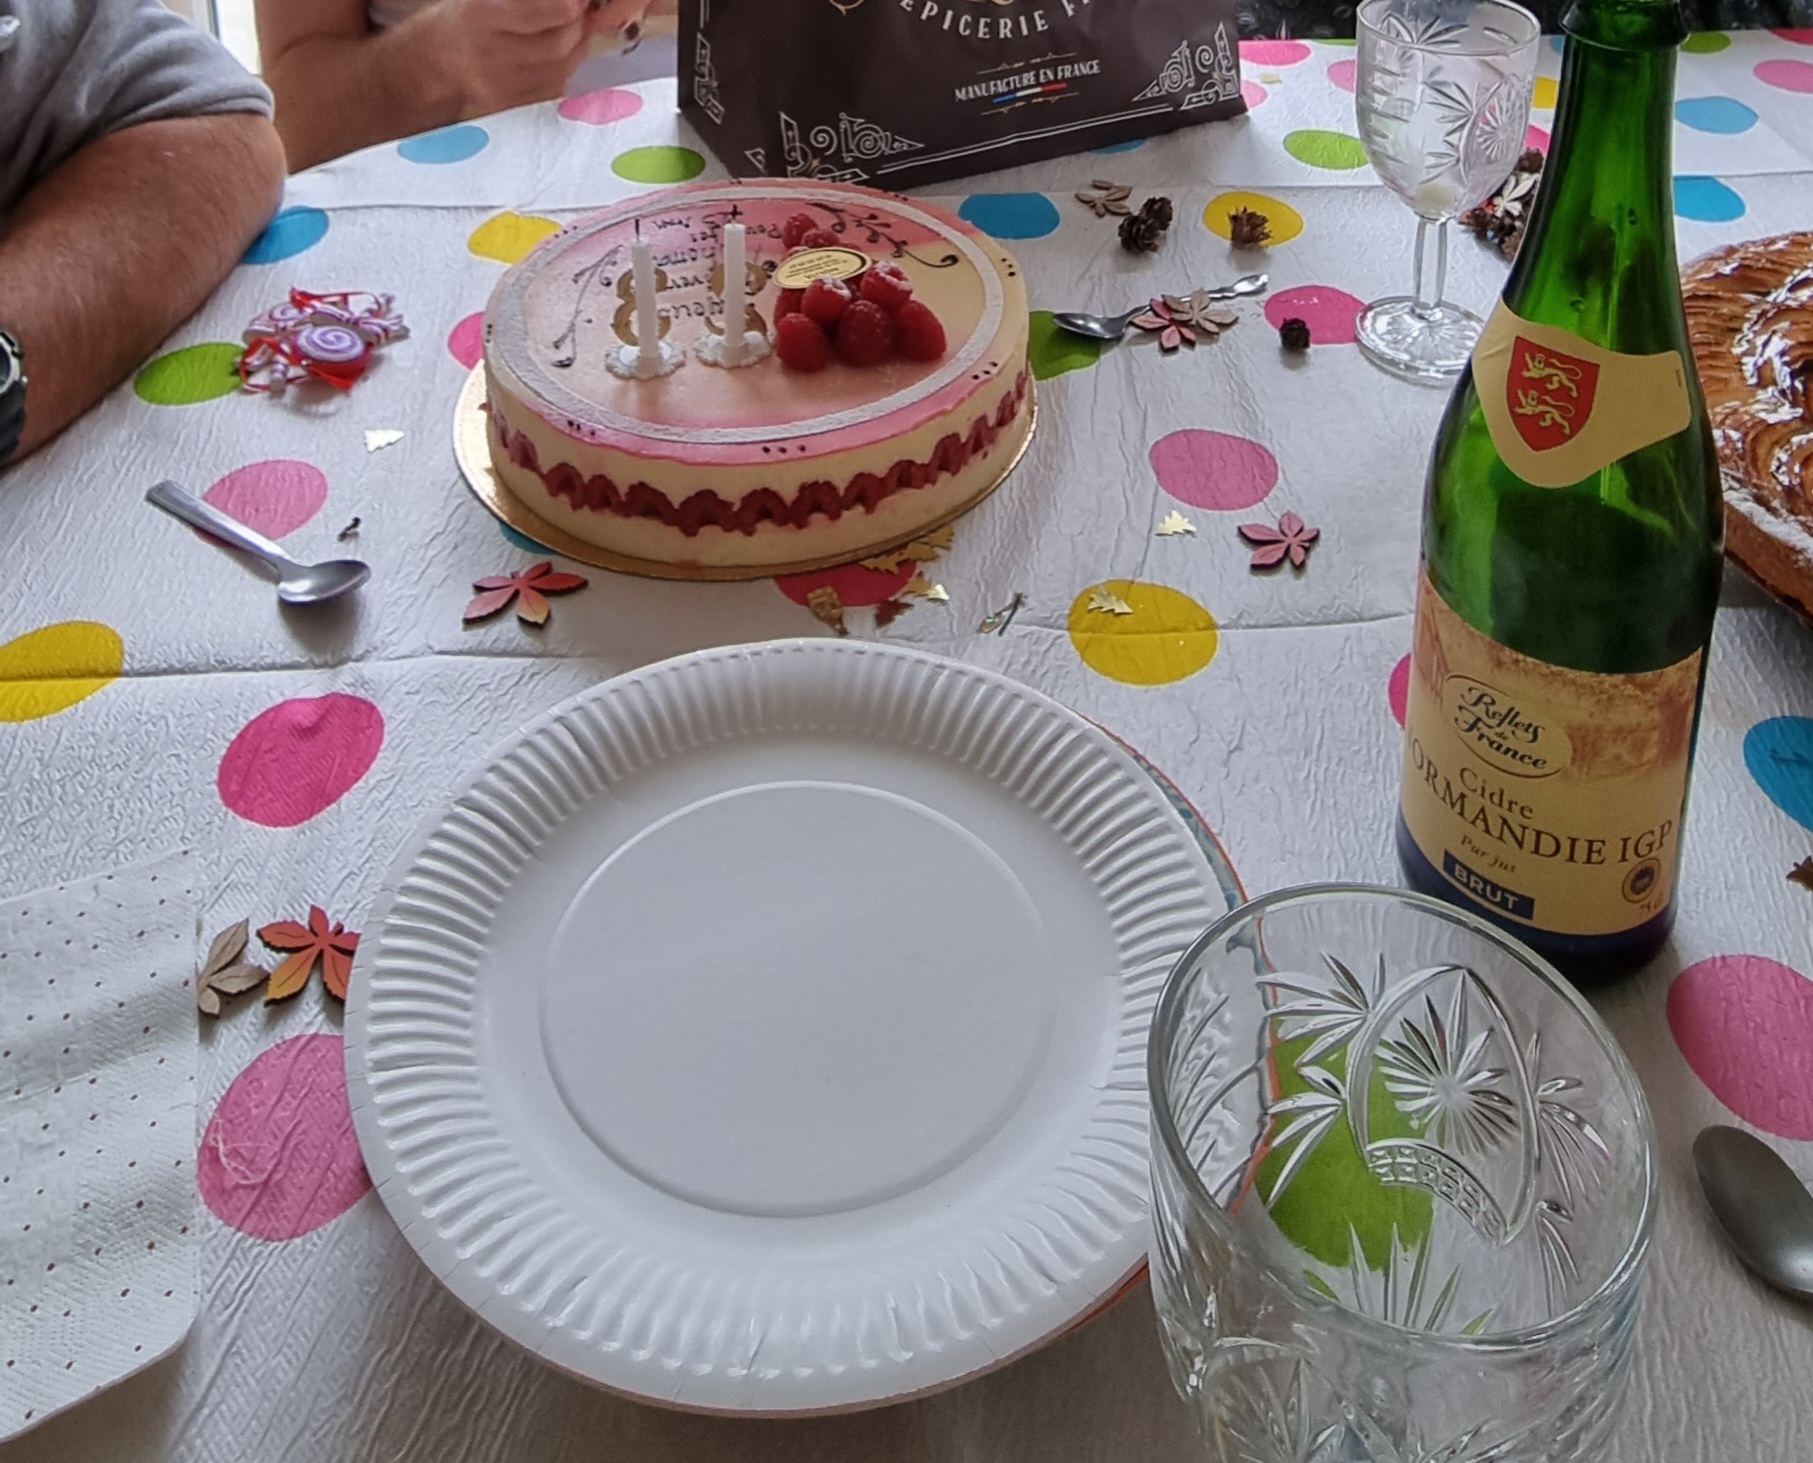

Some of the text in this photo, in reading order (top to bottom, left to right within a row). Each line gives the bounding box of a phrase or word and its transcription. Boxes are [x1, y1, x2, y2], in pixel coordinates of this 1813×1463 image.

[1039, 68, 1055, 83] EN
[1057, 59, 1101, 80] FRANCE
[1454, 702, 1547, 770] France
[1459, 686, 1546, 743] Reflets
[1407, 728, 1673, 865] ORMANDIE IGP
[1459, 767, 1534, 820] Cidre
[1461, 834, 1489, 858] Pur
[1454, 863, 1519, 910] BRUT
